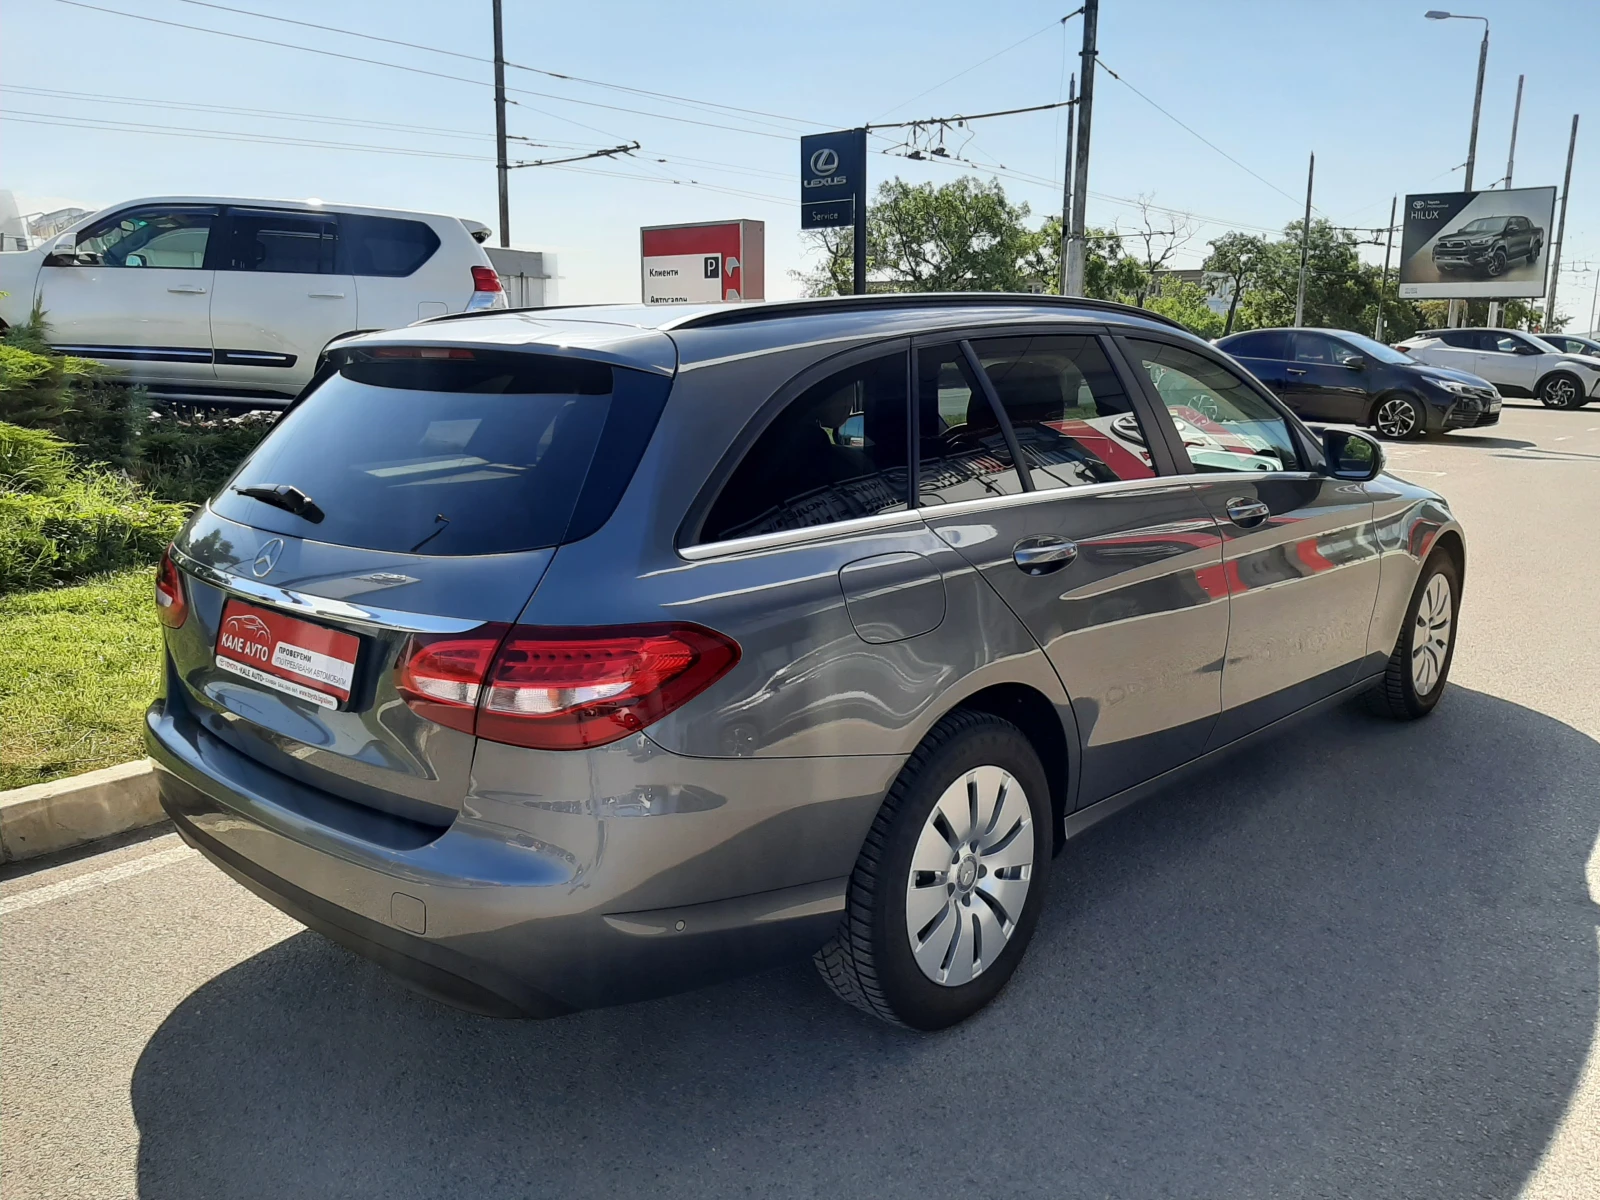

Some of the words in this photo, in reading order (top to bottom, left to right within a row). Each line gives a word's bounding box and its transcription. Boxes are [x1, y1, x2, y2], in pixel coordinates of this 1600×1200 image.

[803, 175, 847, 189] LEXUS
[812, 211, 839, 221] Service
[1411, 210, 1439, 220] HILUX
[649, 268, 679, 277] Клиенти
[707, 259, 716, 277] P
[221, 632, 245, 654] КАЛЕ
[244, 643, 269, 662] АУТО
[278, 646, 312, 663] ПРОВЕРЕНИ
[313, 668, 347, 686] АВТОМОБИЛИ
